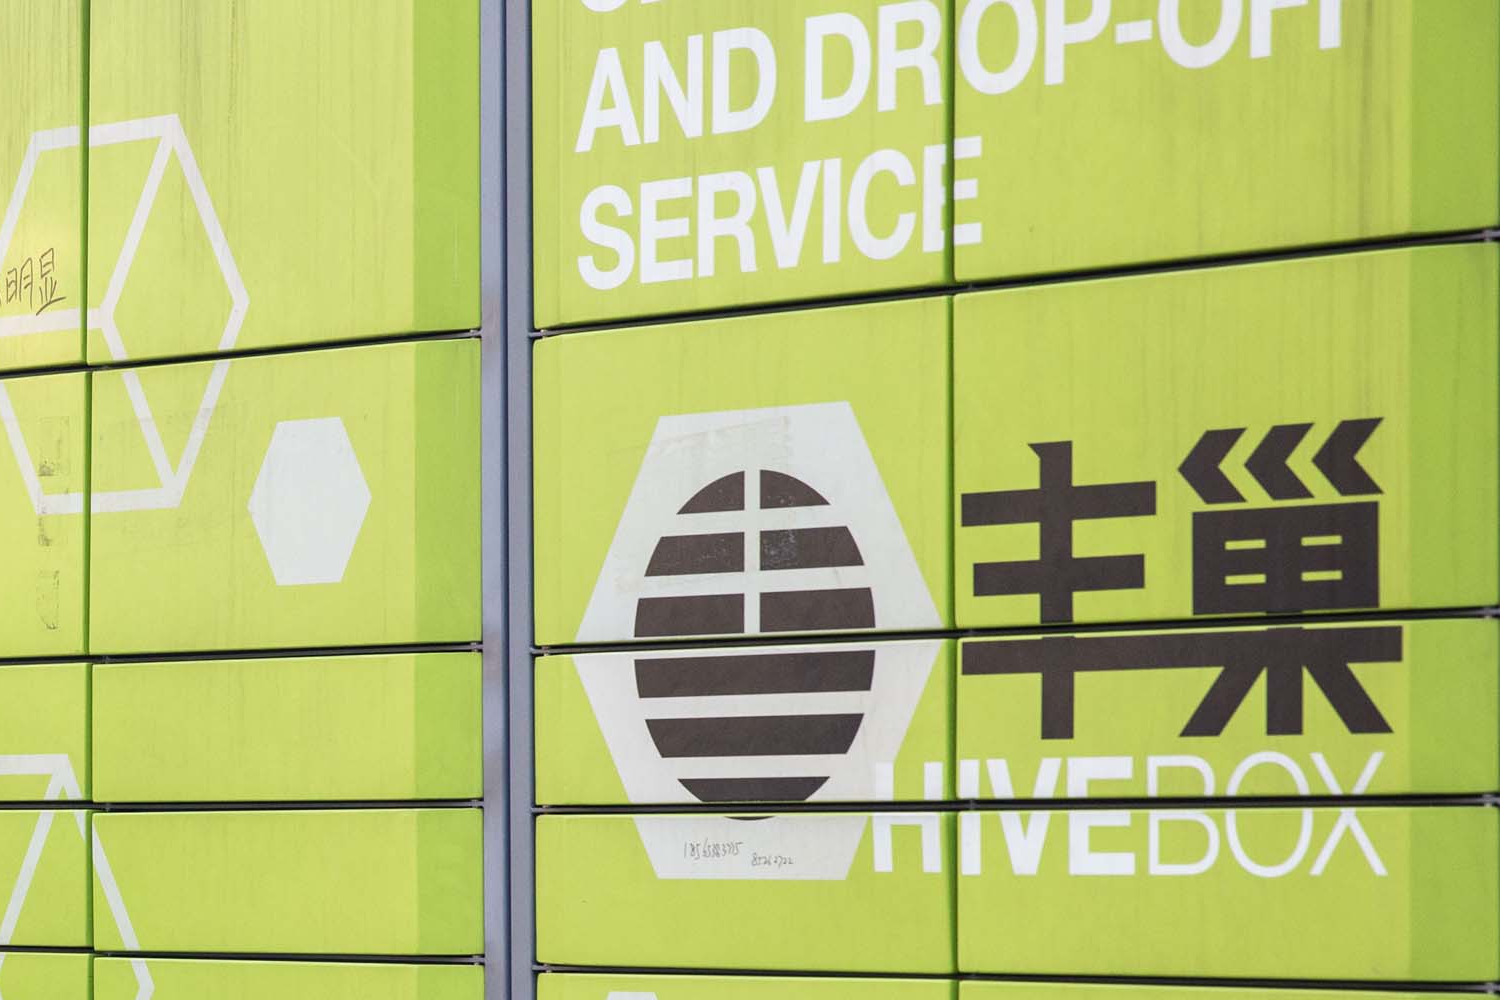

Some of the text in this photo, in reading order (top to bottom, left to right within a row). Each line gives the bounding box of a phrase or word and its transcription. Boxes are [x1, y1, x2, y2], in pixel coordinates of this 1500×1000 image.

[575, 27, 777, 153] AND
[577, 136, 983, 291] SERVICE
[961, 417, 1403, 740] 丰巢
